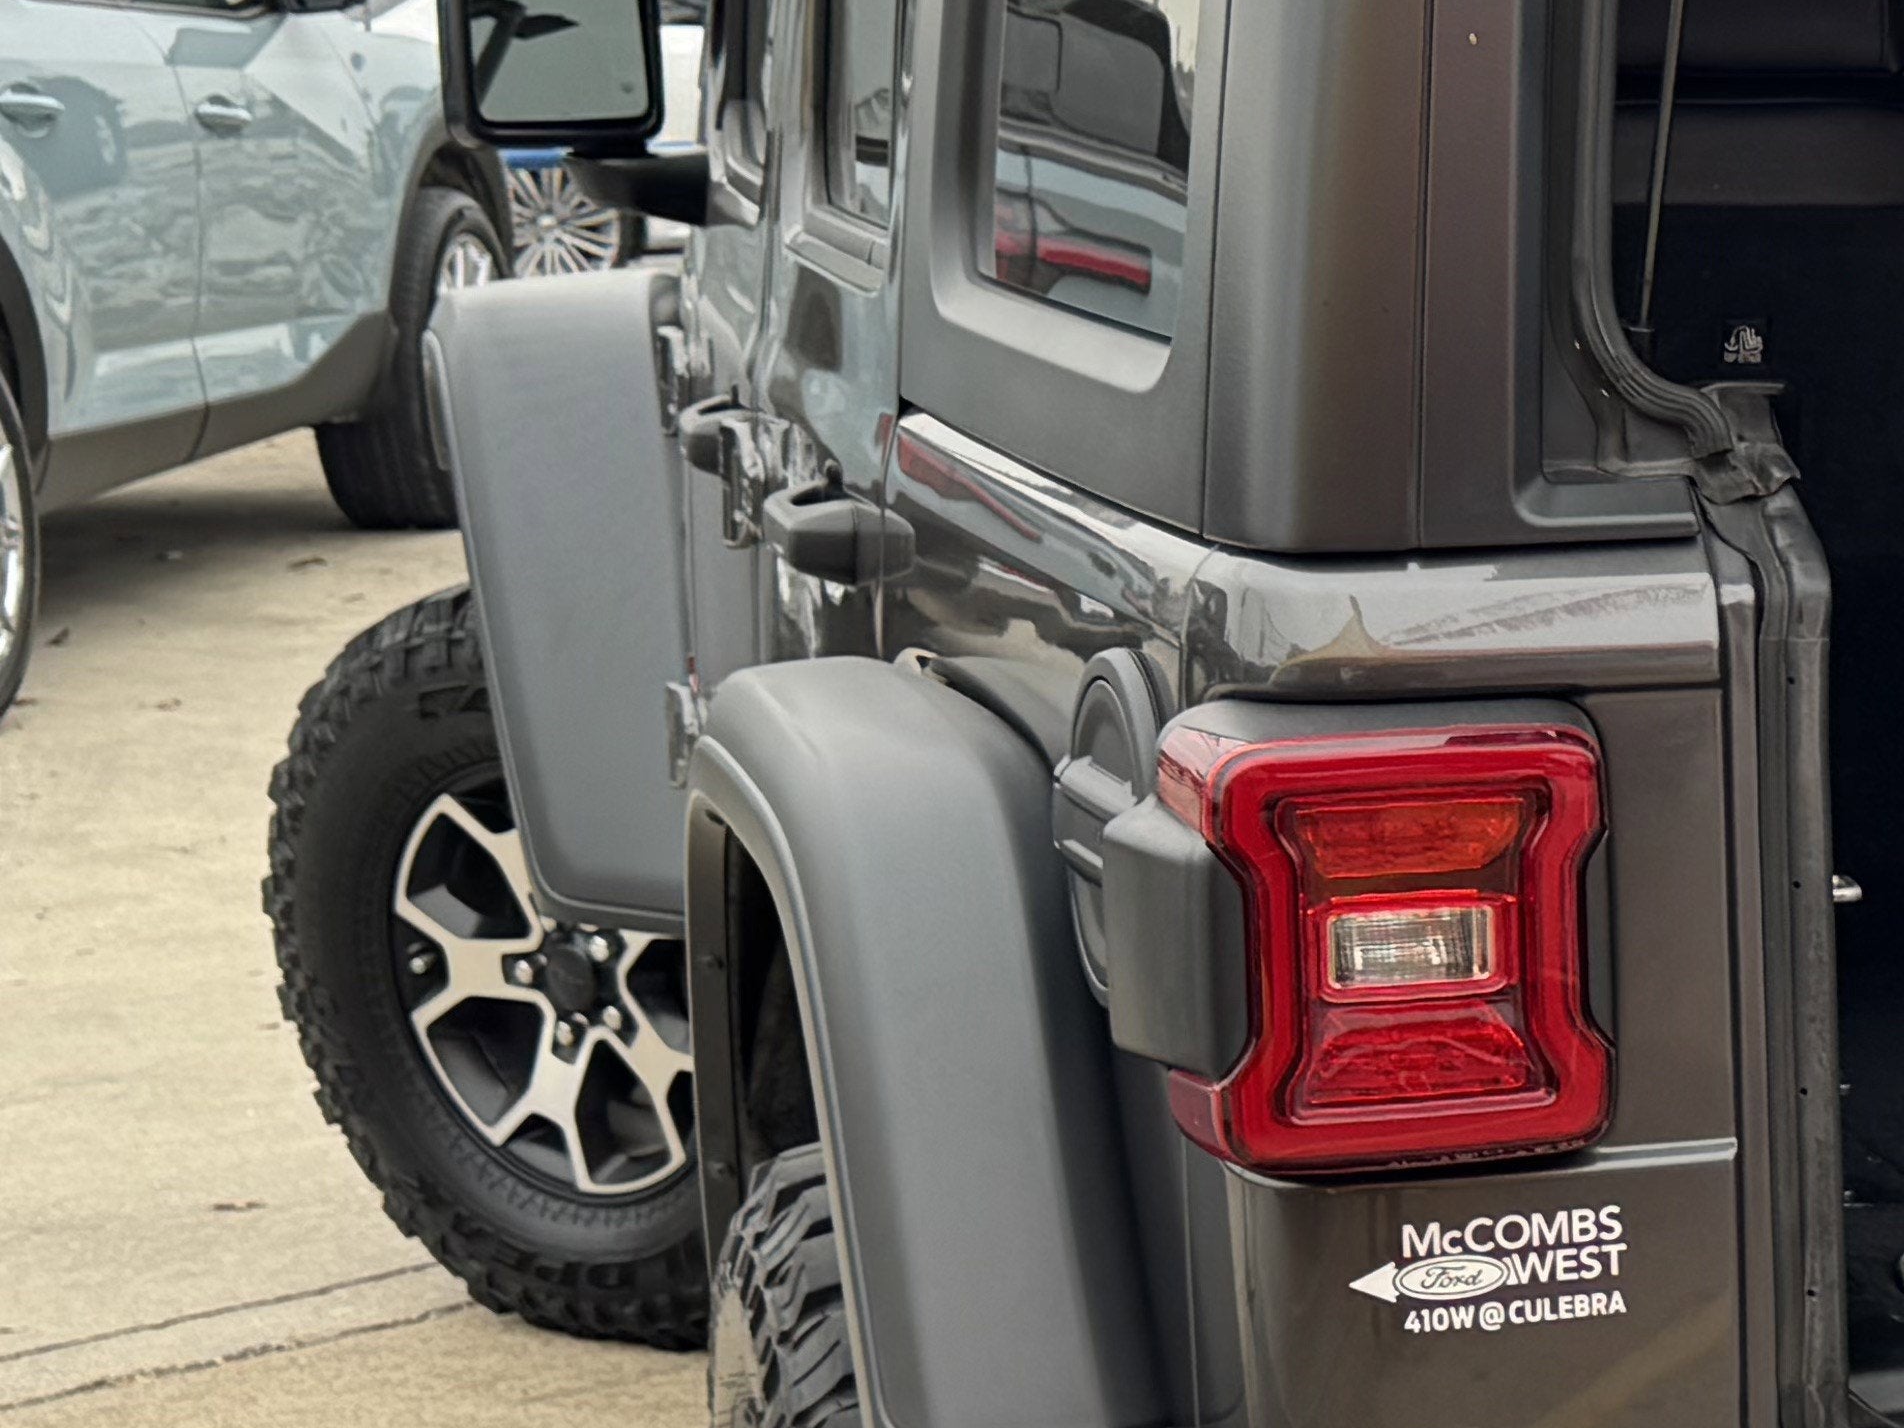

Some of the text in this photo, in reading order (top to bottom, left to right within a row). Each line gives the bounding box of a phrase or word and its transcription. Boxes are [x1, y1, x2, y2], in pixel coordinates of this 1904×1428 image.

[1401, 1204, 1624, 1259] McCOMBS
[1420, 1264, 1484, 1291] Ford
[1503, 1243, 1628, 1286] WEST
